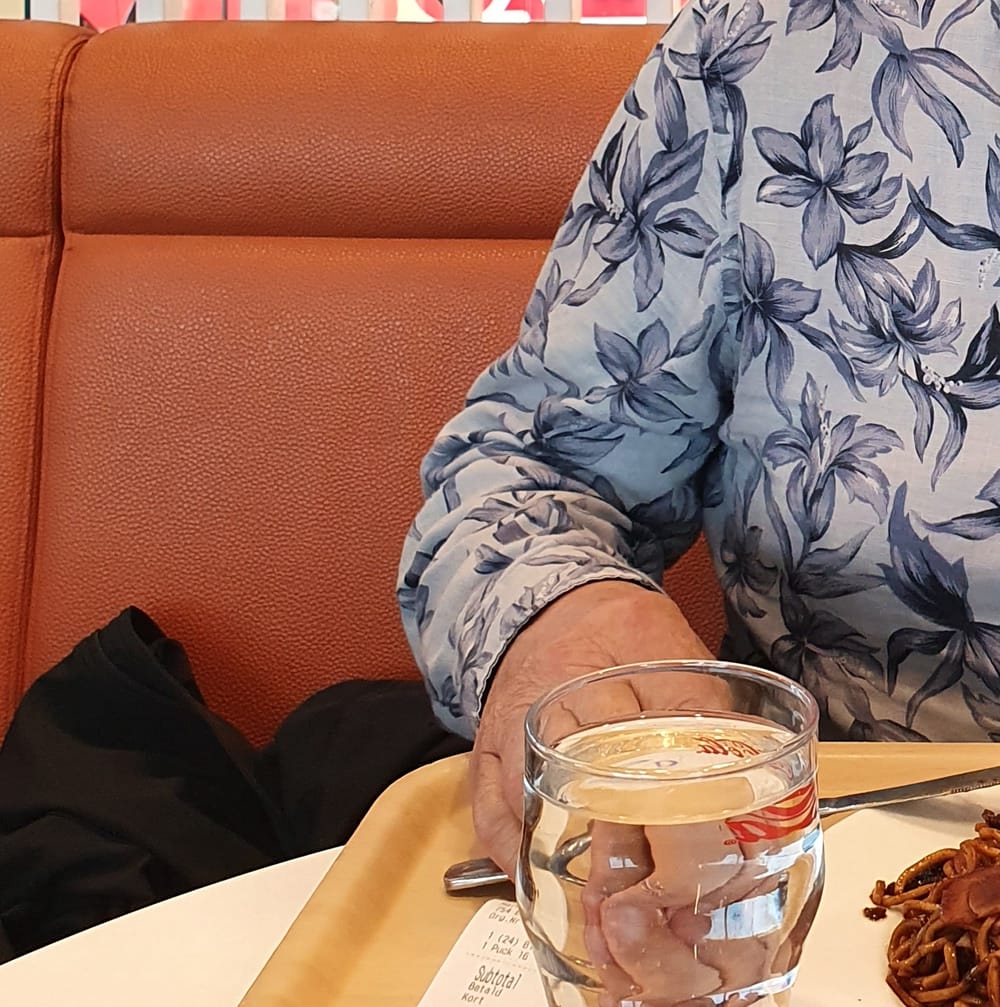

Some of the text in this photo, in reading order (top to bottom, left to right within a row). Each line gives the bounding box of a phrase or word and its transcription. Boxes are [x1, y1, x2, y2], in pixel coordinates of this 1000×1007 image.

[497, 934, 520, 947] (24)
[474, 964, 523, 990] Subtotal
[461, 992, 485, 1005] Kort
